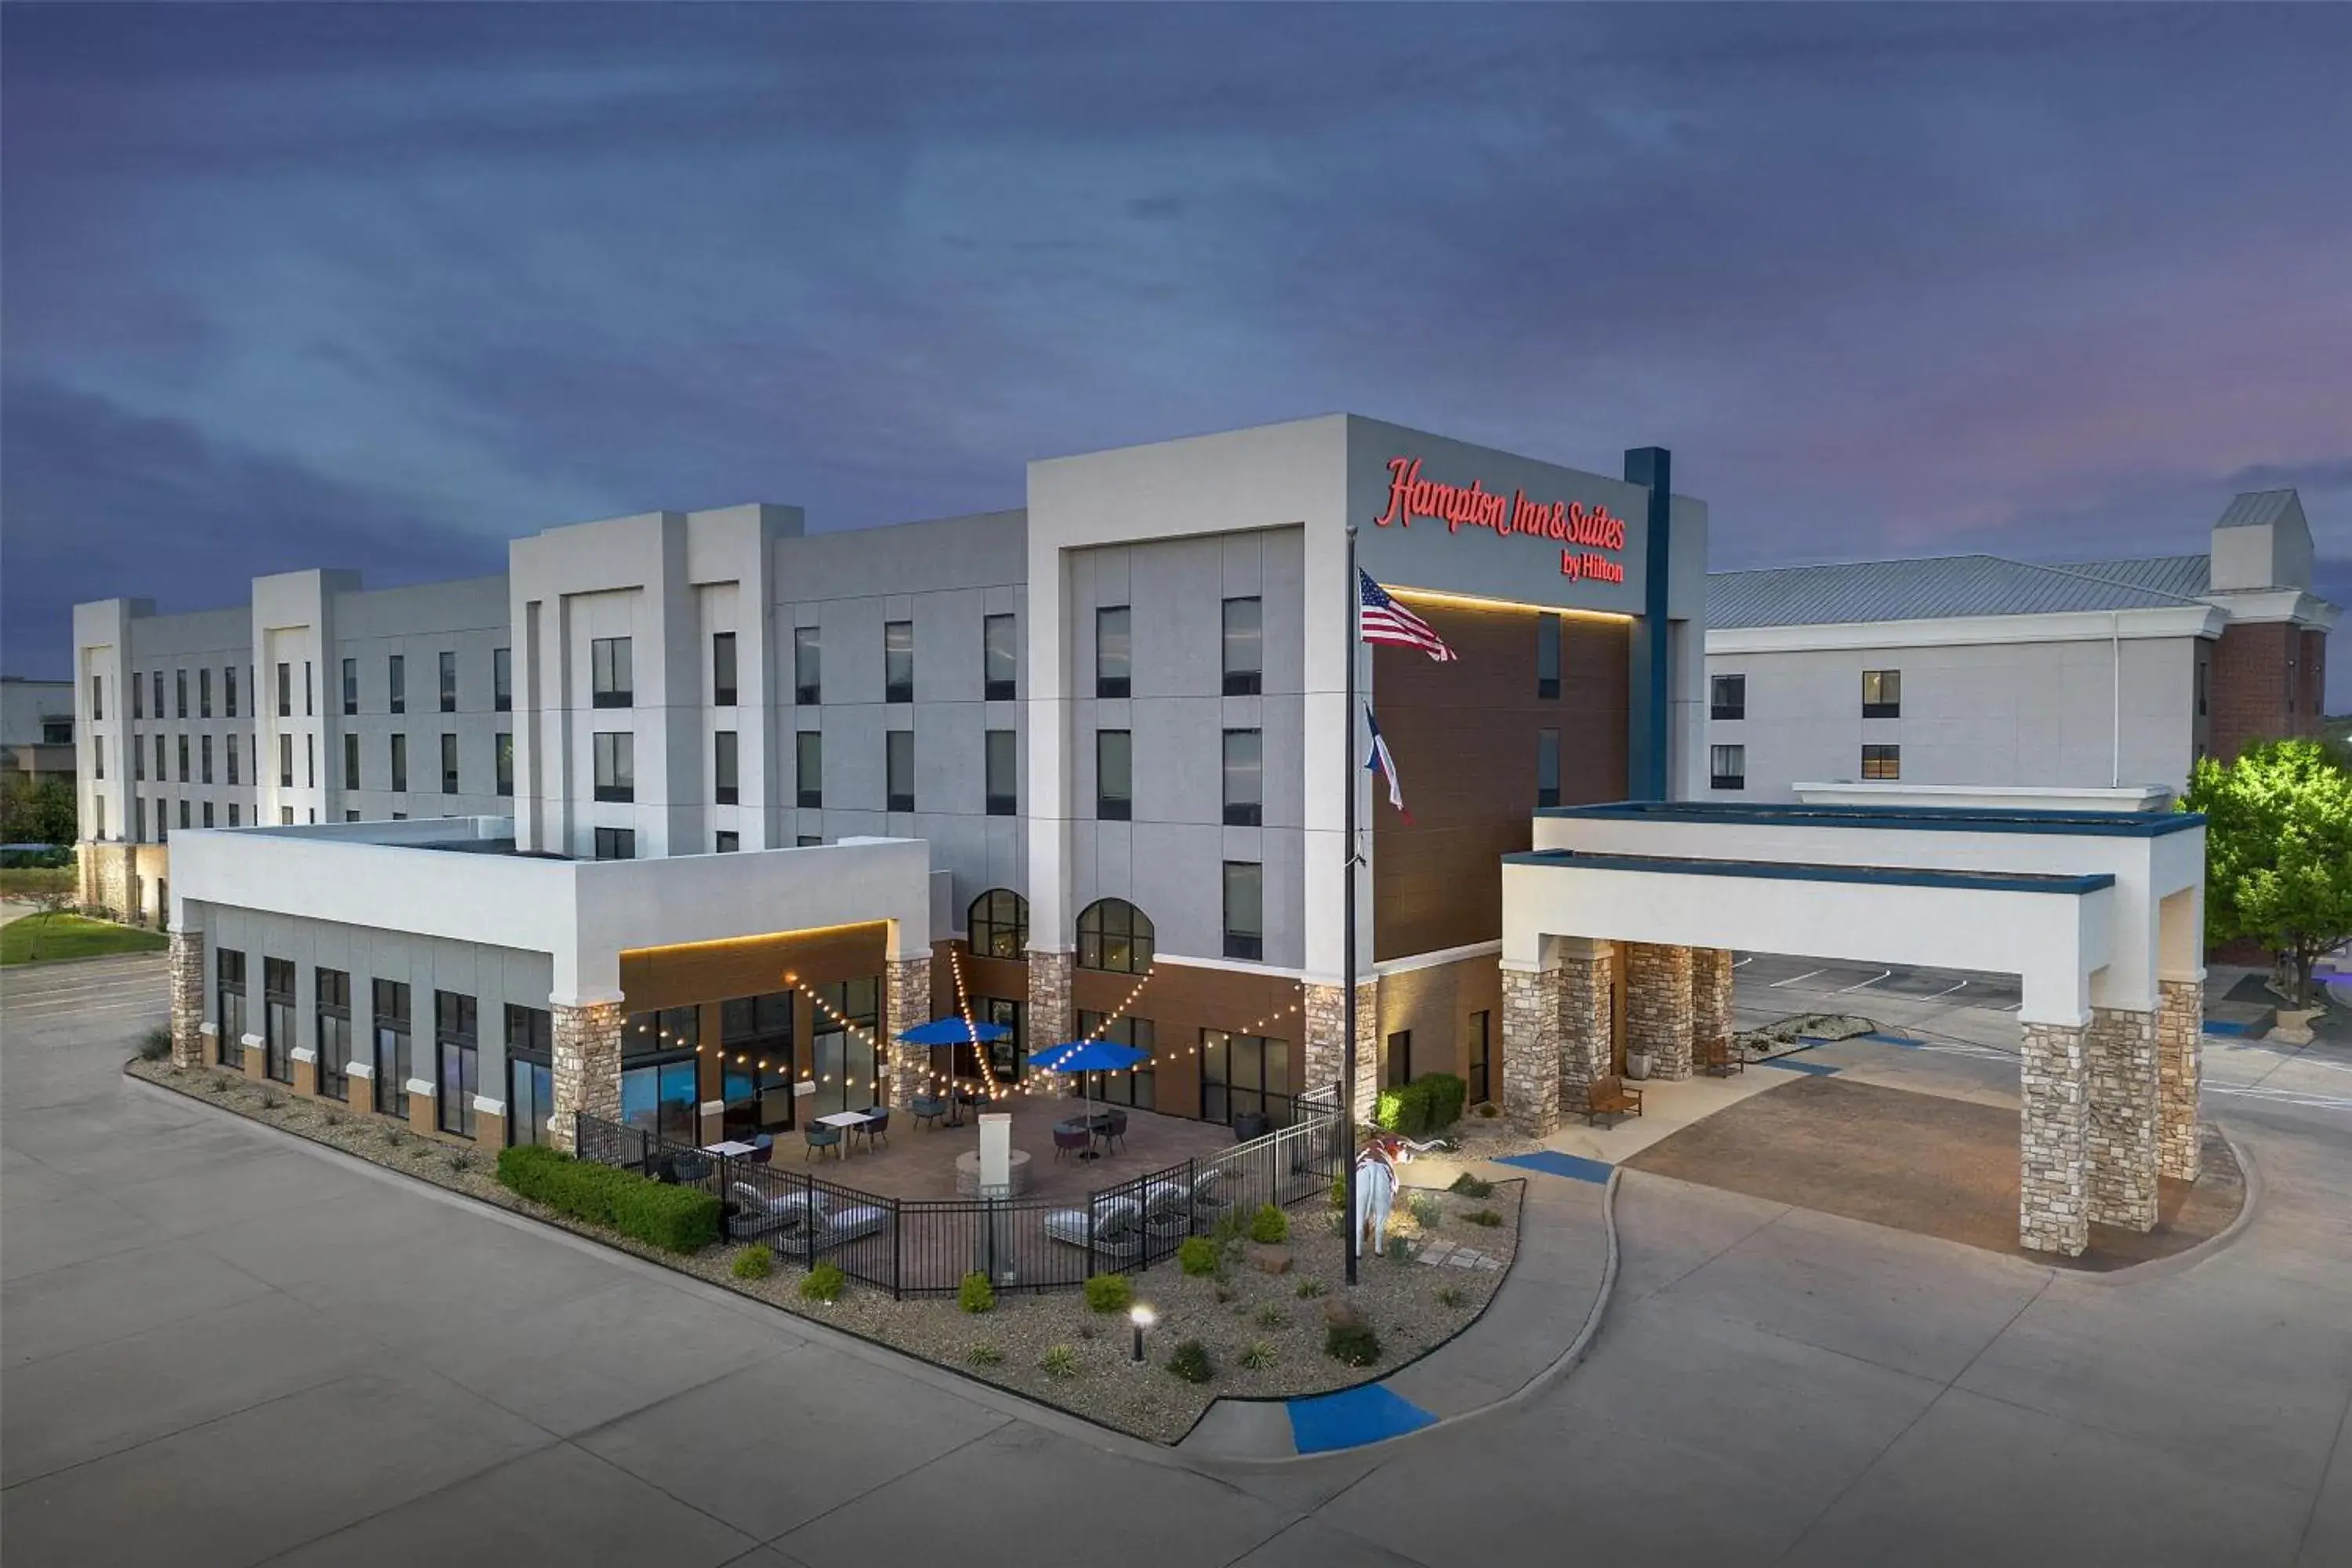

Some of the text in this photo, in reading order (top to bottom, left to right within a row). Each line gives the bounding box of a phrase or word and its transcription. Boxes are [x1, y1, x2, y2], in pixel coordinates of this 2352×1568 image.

[1374, 457, 1510, 536] Hampton
[1561, 549, 1623, 583] by Hilton
